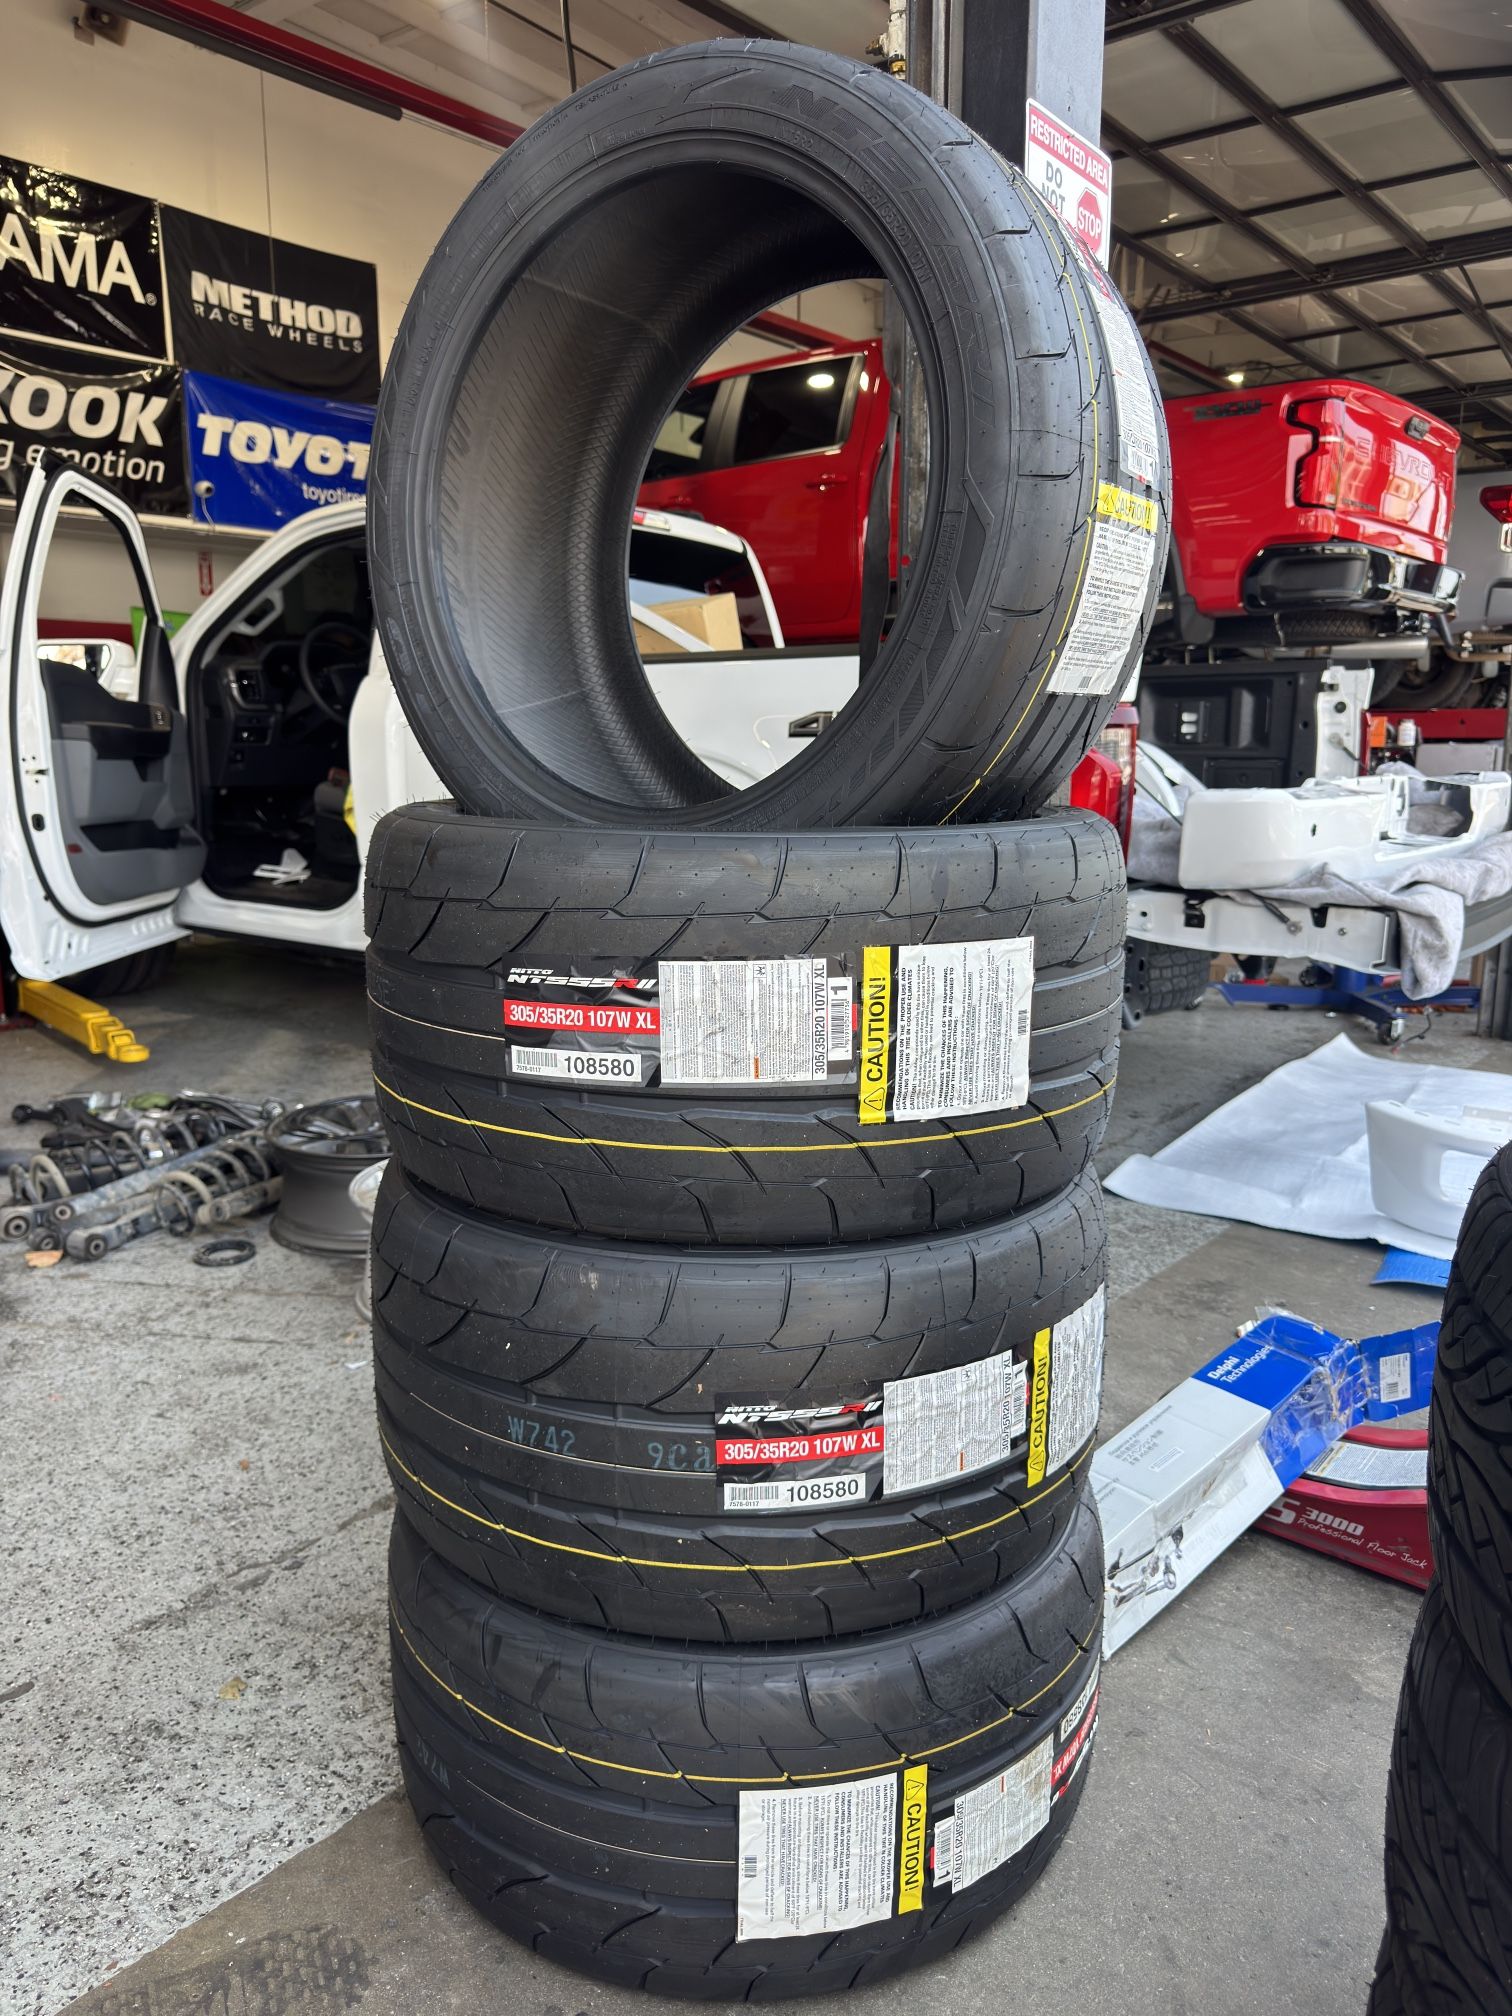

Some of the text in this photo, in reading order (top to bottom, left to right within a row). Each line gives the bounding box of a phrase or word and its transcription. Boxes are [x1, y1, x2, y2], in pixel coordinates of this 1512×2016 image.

[1030, 114, 1108, 188] RESTRICTED AREA
[1046, 159, 1063, 189] DO
[1042, 182, 1066, 215] NOT
[1078, 206, 1101, 239] STOP
[190, 270, 364, 338] METHOD
[193, 303, 364, 353] RACE WHEELS
[510, 967, 554, 975] NITTO
[831, 986, 847, 995] 1
[510, 1004, 656, 1029] 305/35R20 107W XL
[814, 965, 825, 1074] 305/35R20 107W XL
[867, 977, 886, 1082] CAUTION!
[564, 1056, 635, 1077] 108580
[896, 1050, 904, 1110] RECOMMENDATIONS
[900, 1039, 904, 1048] ON
[938, 1100, 942, 1108] TO
[942, 1020, 946, 1028] OF
[1207, 1355, 1240, 1380] Delphi
[1220, 1344, 1274, 1383] Technologies
[725, 1405, 777, 1413] NITTO
[1001, 1356, 1012, 1452] 305/35R20 107W XL
[1033, 1356, 1047, 1448] CAUTION!
[508, 1416, 576, 1456] W742
[724, 1431, 880, 1460] 305/35R20 107W XL
[786, 1479, 859, 1502] 108580
[1302, 1507, 1365, 1536] 3000
[1297, 1518, 1428, 1569] Professional Floor Jack
[905, 1803, 921, 1891] CAUTION!
[954, 1801, 964, 1887] 305/35R20 107W XL
[938, 1870, 950, 1879] 1
